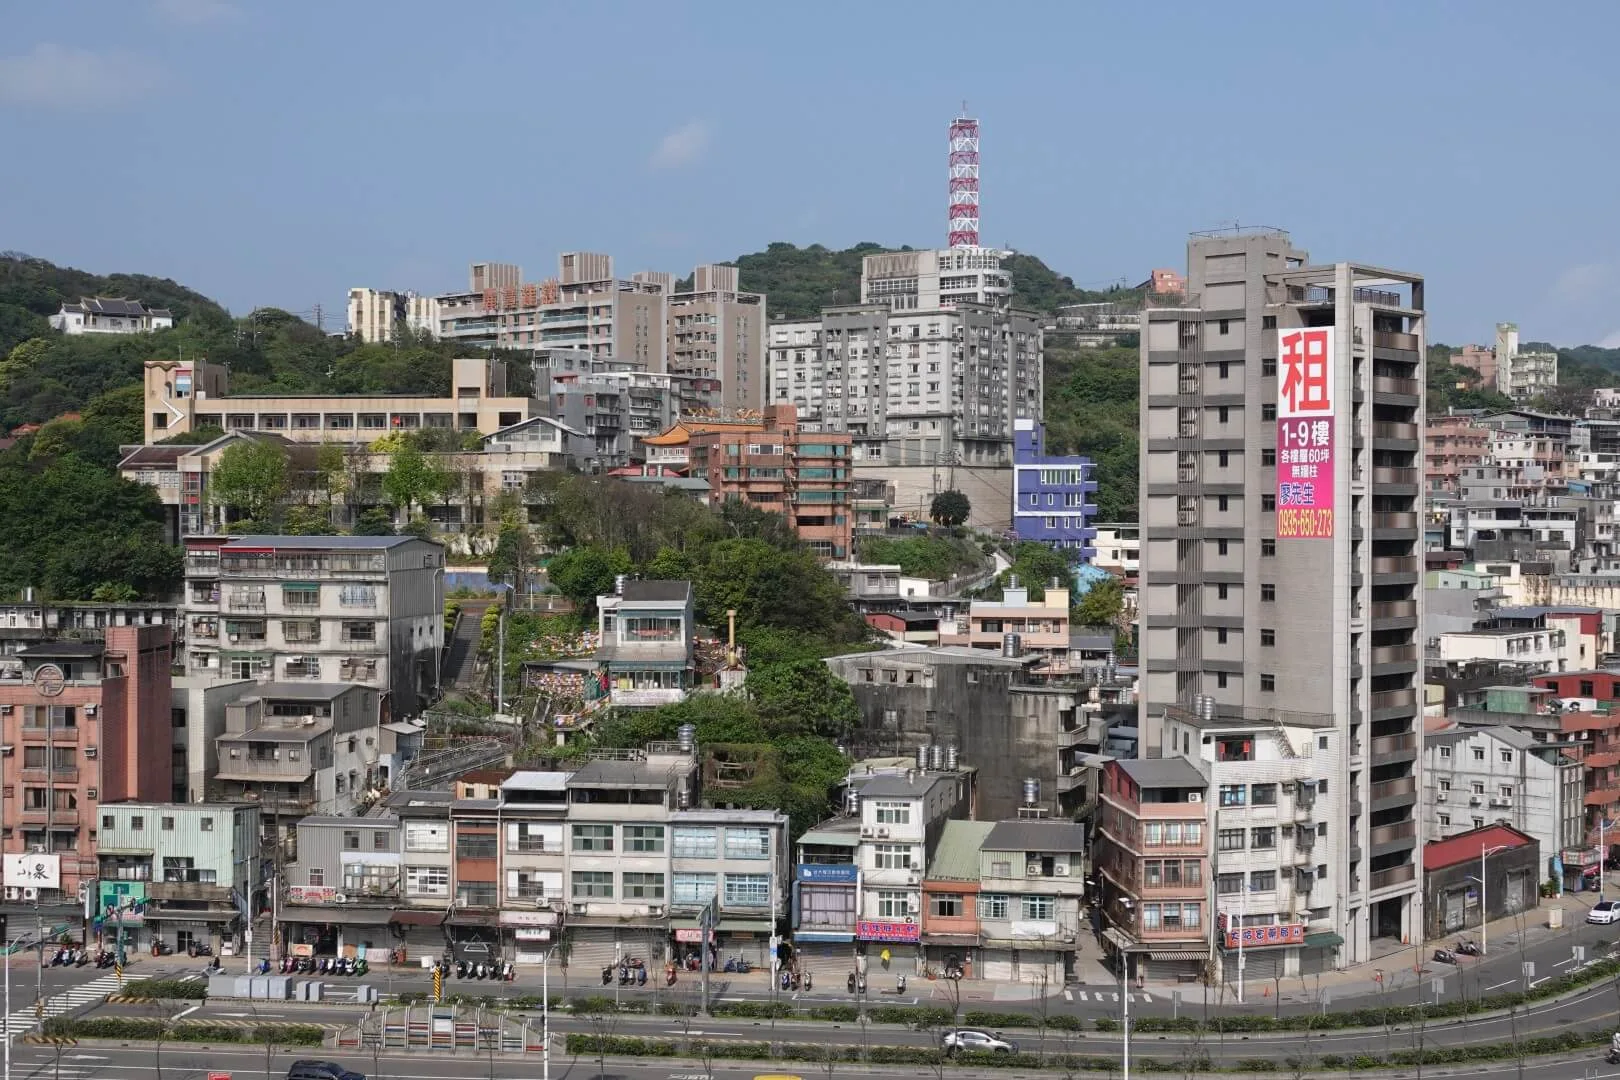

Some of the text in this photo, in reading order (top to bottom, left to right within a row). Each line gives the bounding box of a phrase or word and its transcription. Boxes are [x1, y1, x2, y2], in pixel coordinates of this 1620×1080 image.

[1281, 331, 1330, 413] 租
[1279, 482, 1315, 506] 廖先生
